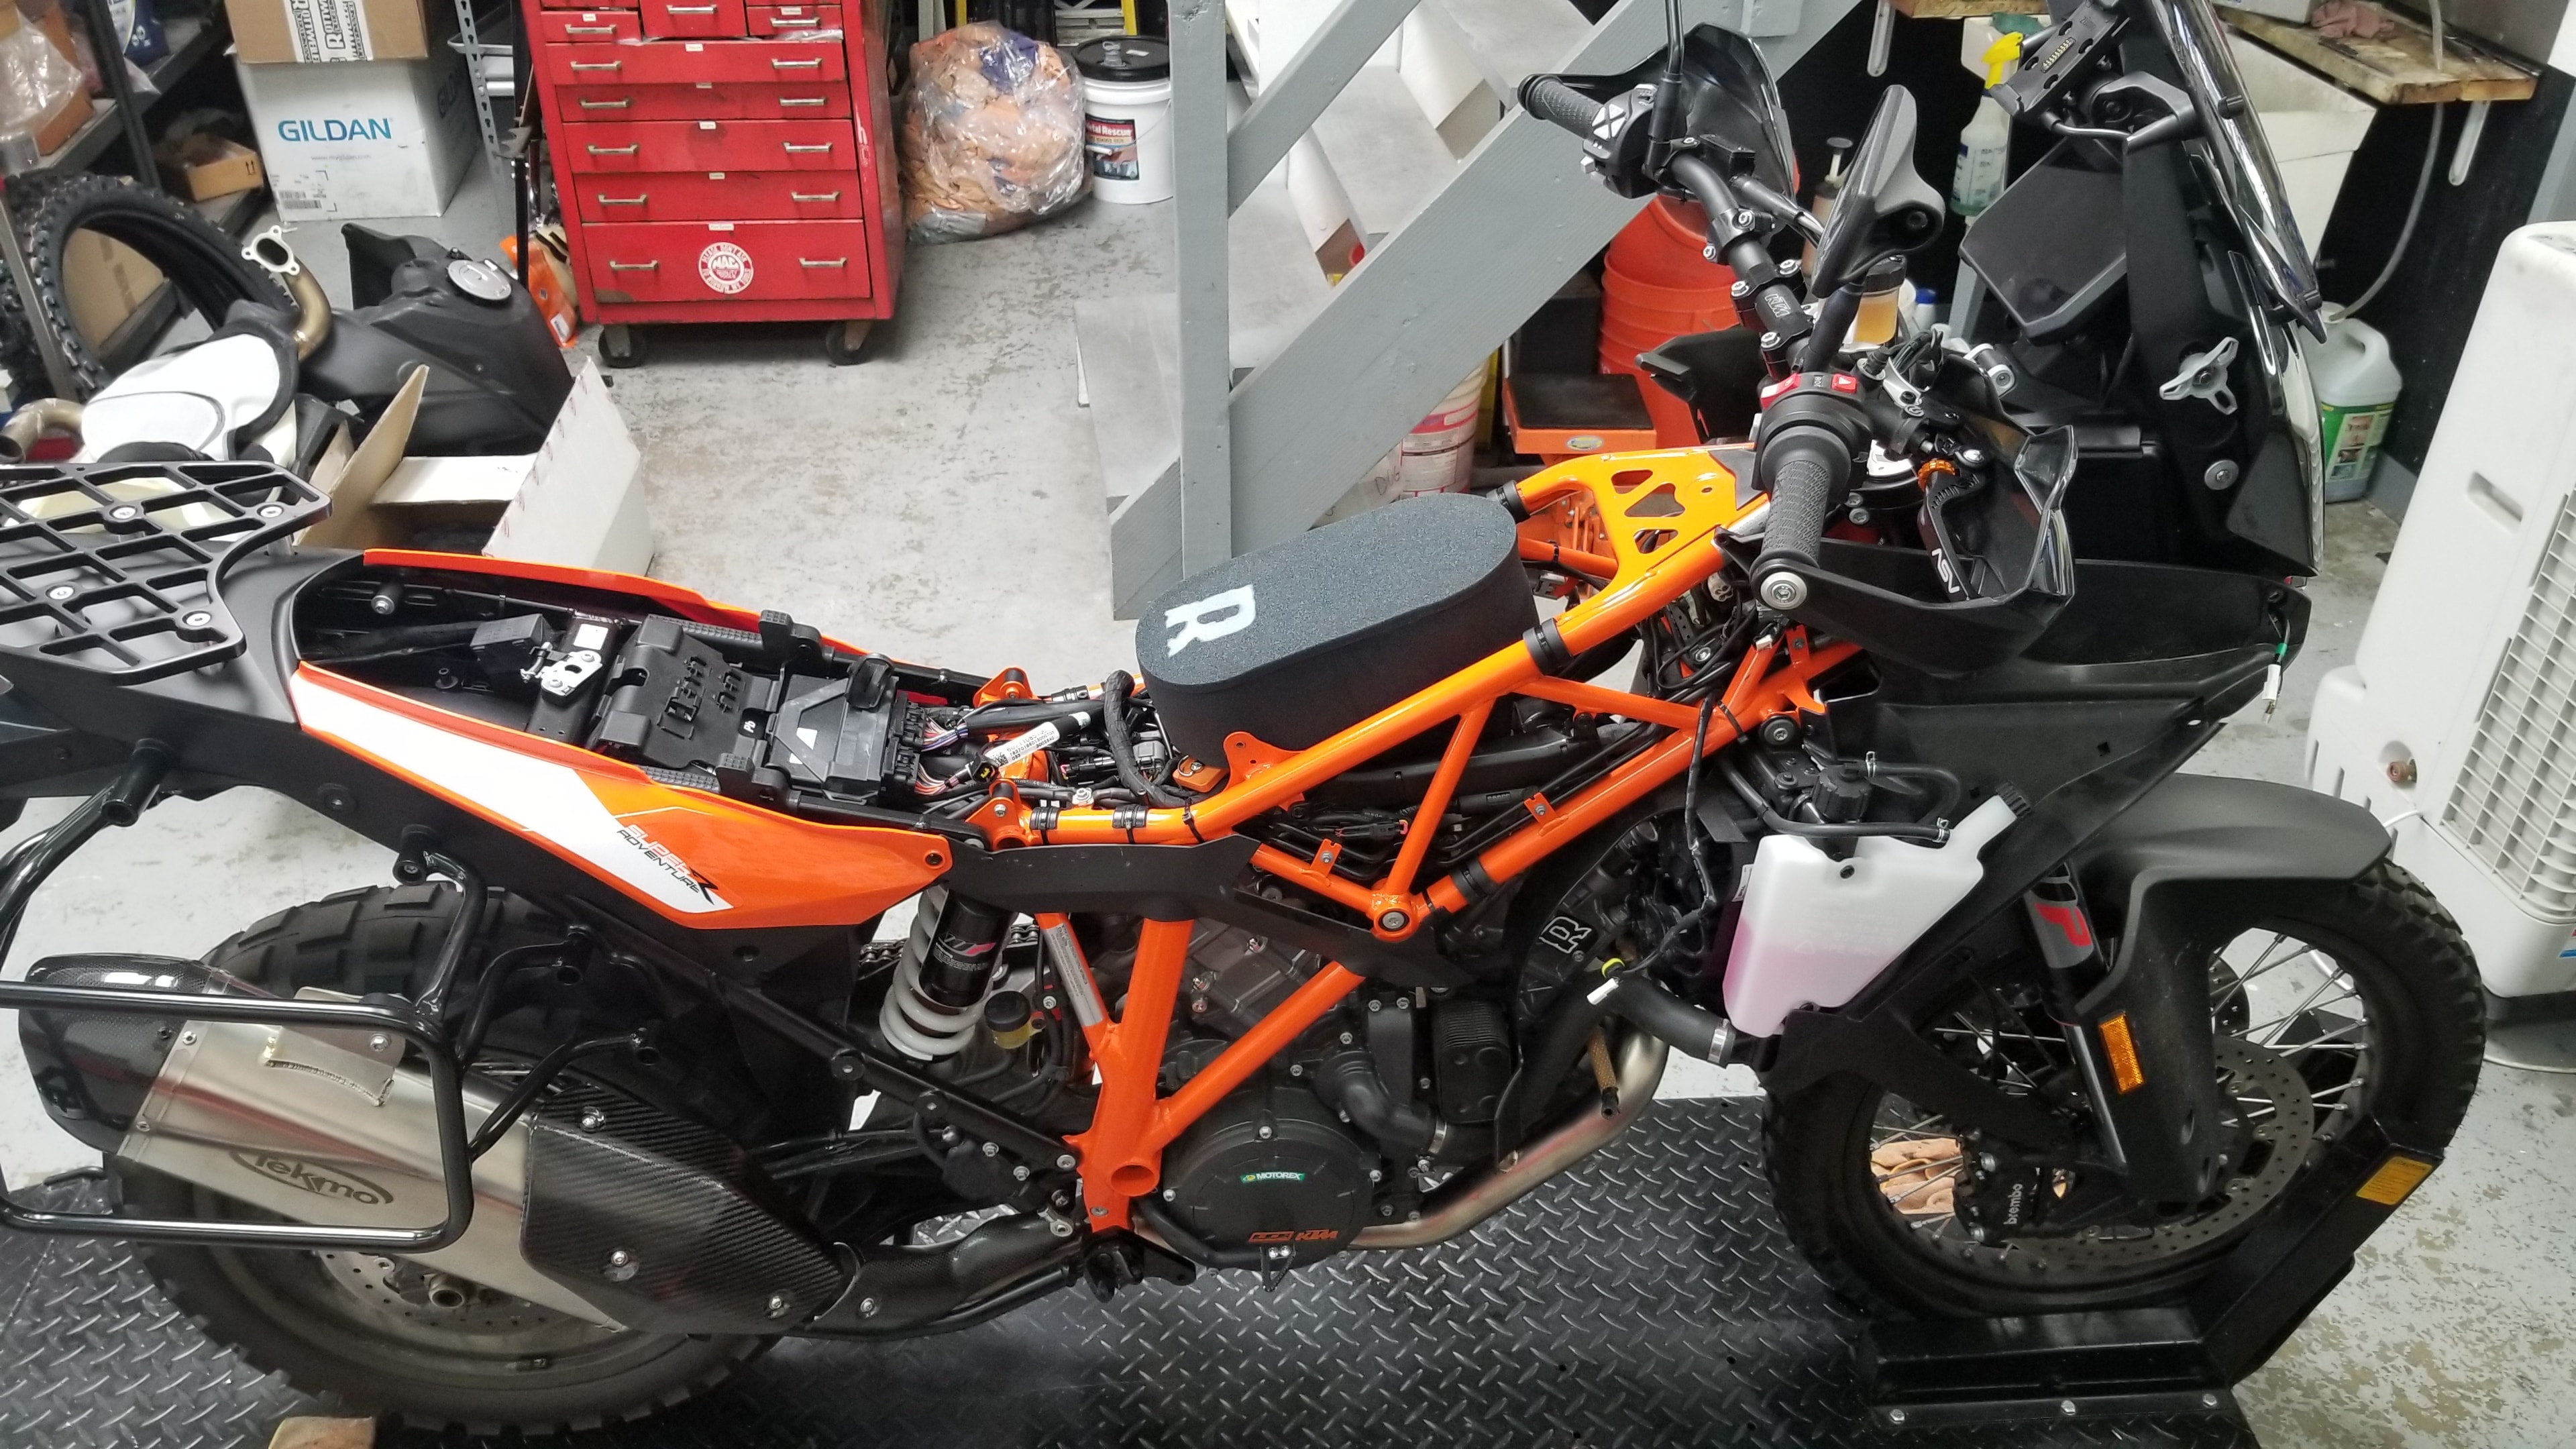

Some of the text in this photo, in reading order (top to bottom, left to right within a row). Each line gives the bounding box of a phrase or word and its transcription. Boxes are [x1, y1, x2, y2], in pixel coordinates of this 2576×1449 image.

[278, 118, 392, 142] GILDAN
[711, 256, 739, 269] MAC
[1764, 293, 1791, 318] KTM
[1165, 584, 1256, 658] R
[743, 720, 756, 734] Pb
[616, 829, 700, 894] ADVENTURE
[1538, 916, 1593, 954] R
[1256, 1171, 1301, 1180] MOTOREX
[2002, 1183, 2023, 1225] brembo
[1295, 1229, 1338, 1241] KTM
